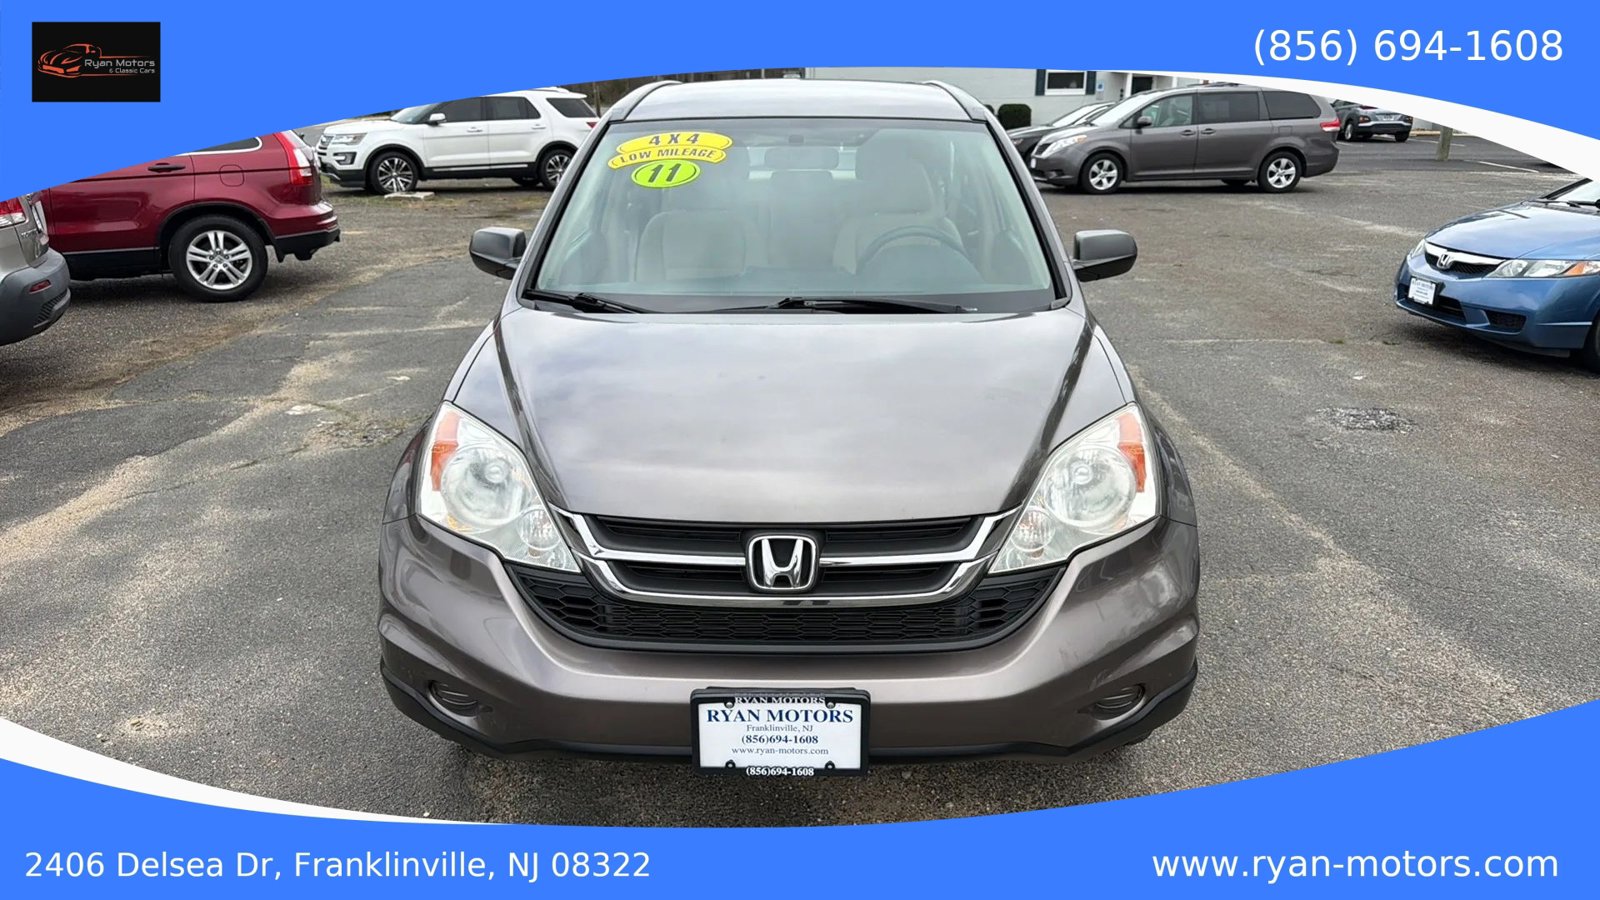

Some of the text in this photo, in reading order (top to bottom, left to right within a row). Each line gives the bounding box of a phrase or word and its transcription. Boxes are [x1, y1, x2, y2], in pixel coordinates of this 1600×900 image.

[620, 147, 717, 163] LOW MILEAGE
[648, 163, 682, 183] 11
[735, 696, 826, 704] RYAN MOTORS
[707, 709, 853, 723] RYAN MOTORS
[746, 724, 813, 733] Franklinville, NJ
[741, 734, 819, 745] (856)694-1608
[731, 747, 829, 756] www.ryan-motors.com
[746, 766, 815, 777] (856)694-1608
